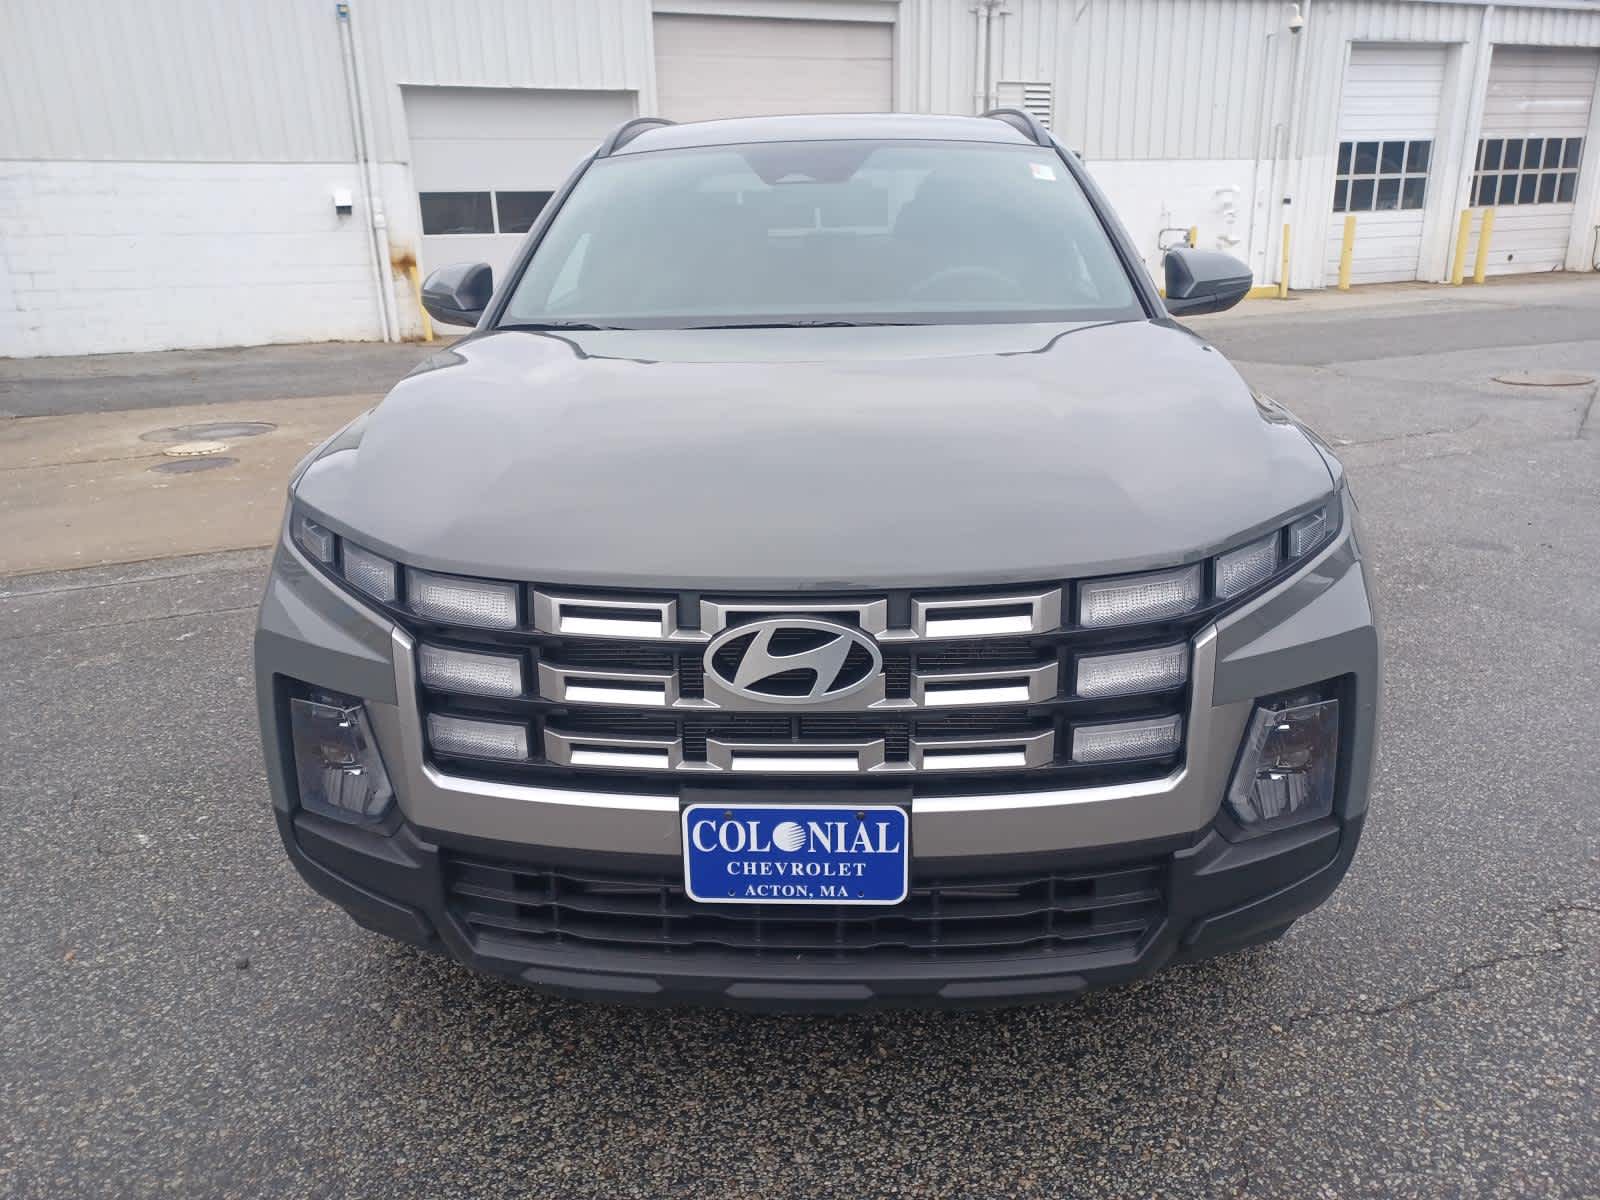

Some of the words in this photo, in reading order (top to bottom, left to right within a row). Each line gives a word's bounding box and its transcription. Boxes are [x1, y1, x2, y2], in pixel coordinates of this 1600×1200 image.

[726, 861, 867, 877] CHEVROLET
[745, 884, 814, 899] ACTON,
[820, 885, 848, 897] MA
